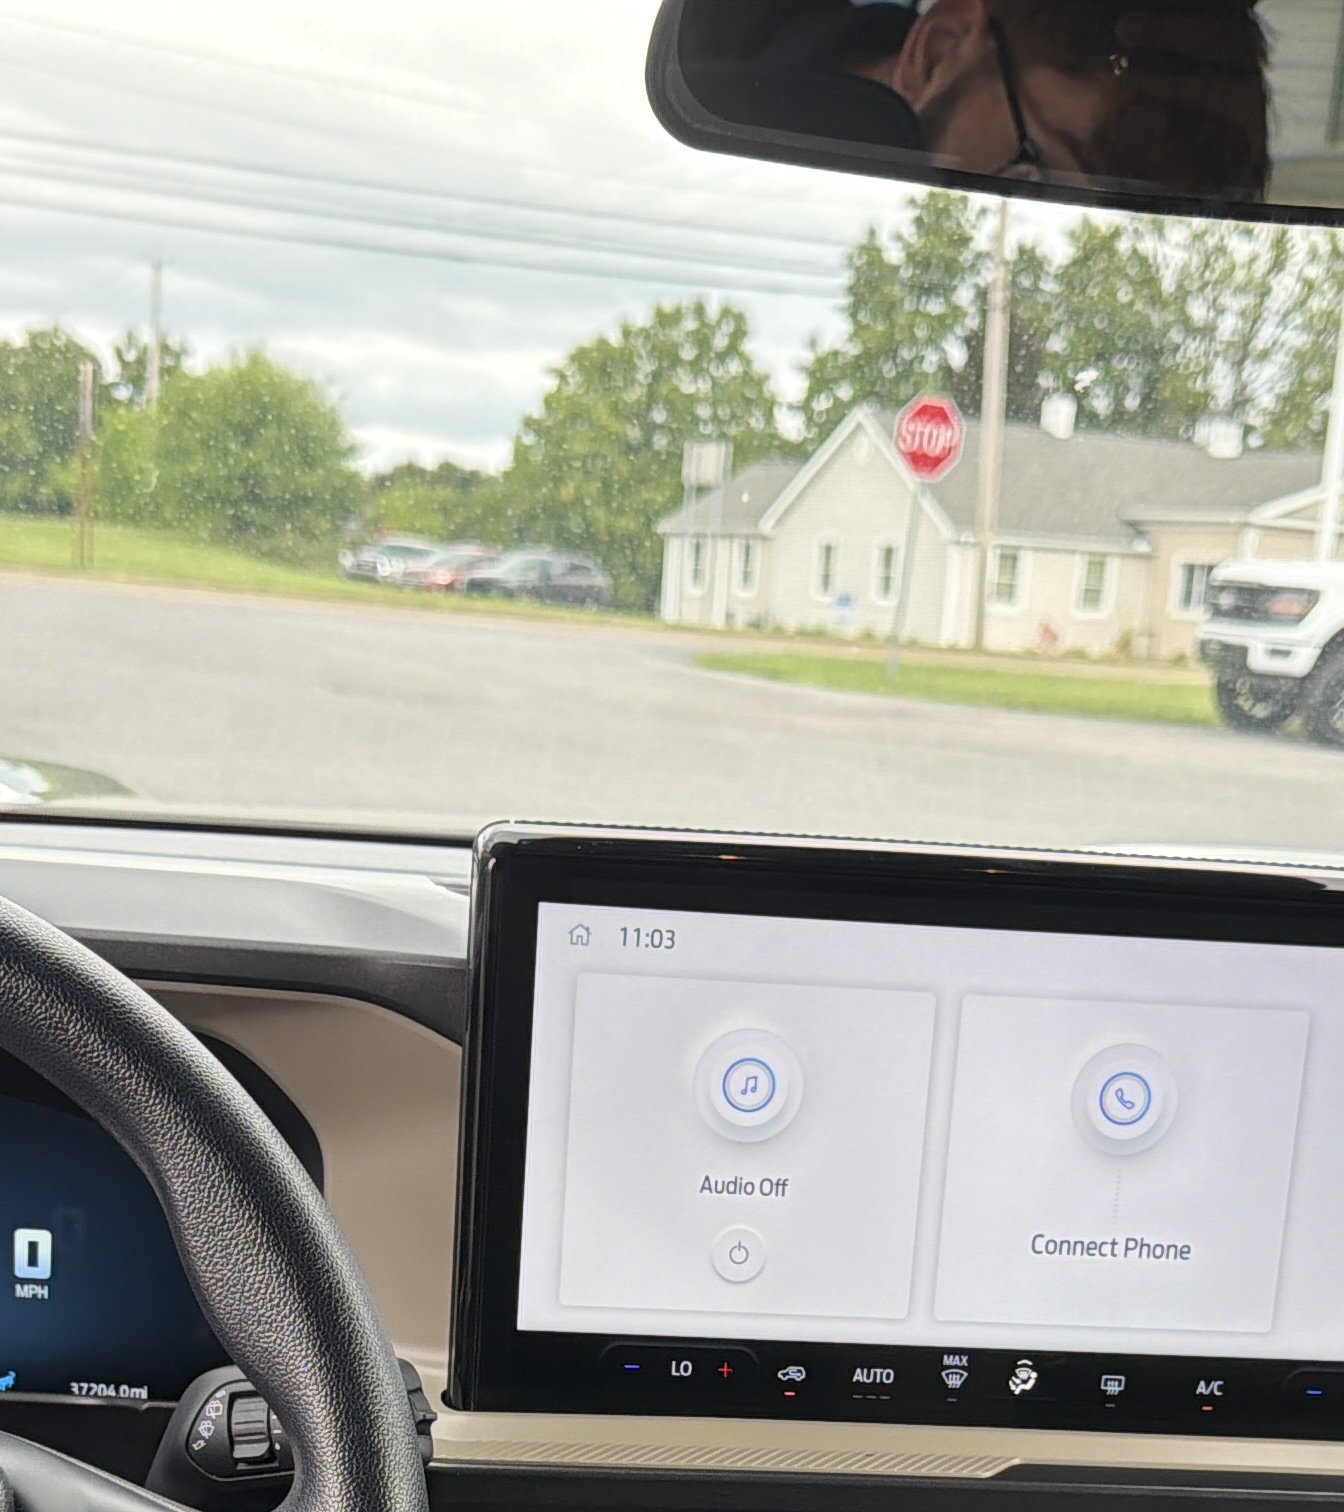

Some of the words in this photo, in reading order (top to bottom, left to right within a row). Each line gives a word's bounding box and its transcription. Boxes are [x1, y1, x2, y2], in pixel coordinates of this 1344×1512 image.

[898, 420, 954, 457] STOP
[620, 926, 676, 950] 11:03
[699, 1174, 756, 1196] Audio
[759, 1177, 790, 1198] Off
[14, 1228, 52, 1280] 0
[1031, 1233, 1120, 1258] Connect
[1123, 1237, 1192, 1261] Phone
[14, 1283, 49, 1300] MPH
[670, 1360, 693, 1378] LO
[942, 1354, 969, 1368] MAX
[852, 1367, 895, 1385] AUTO
[1195, 1380, 1226, 1397] A/C
